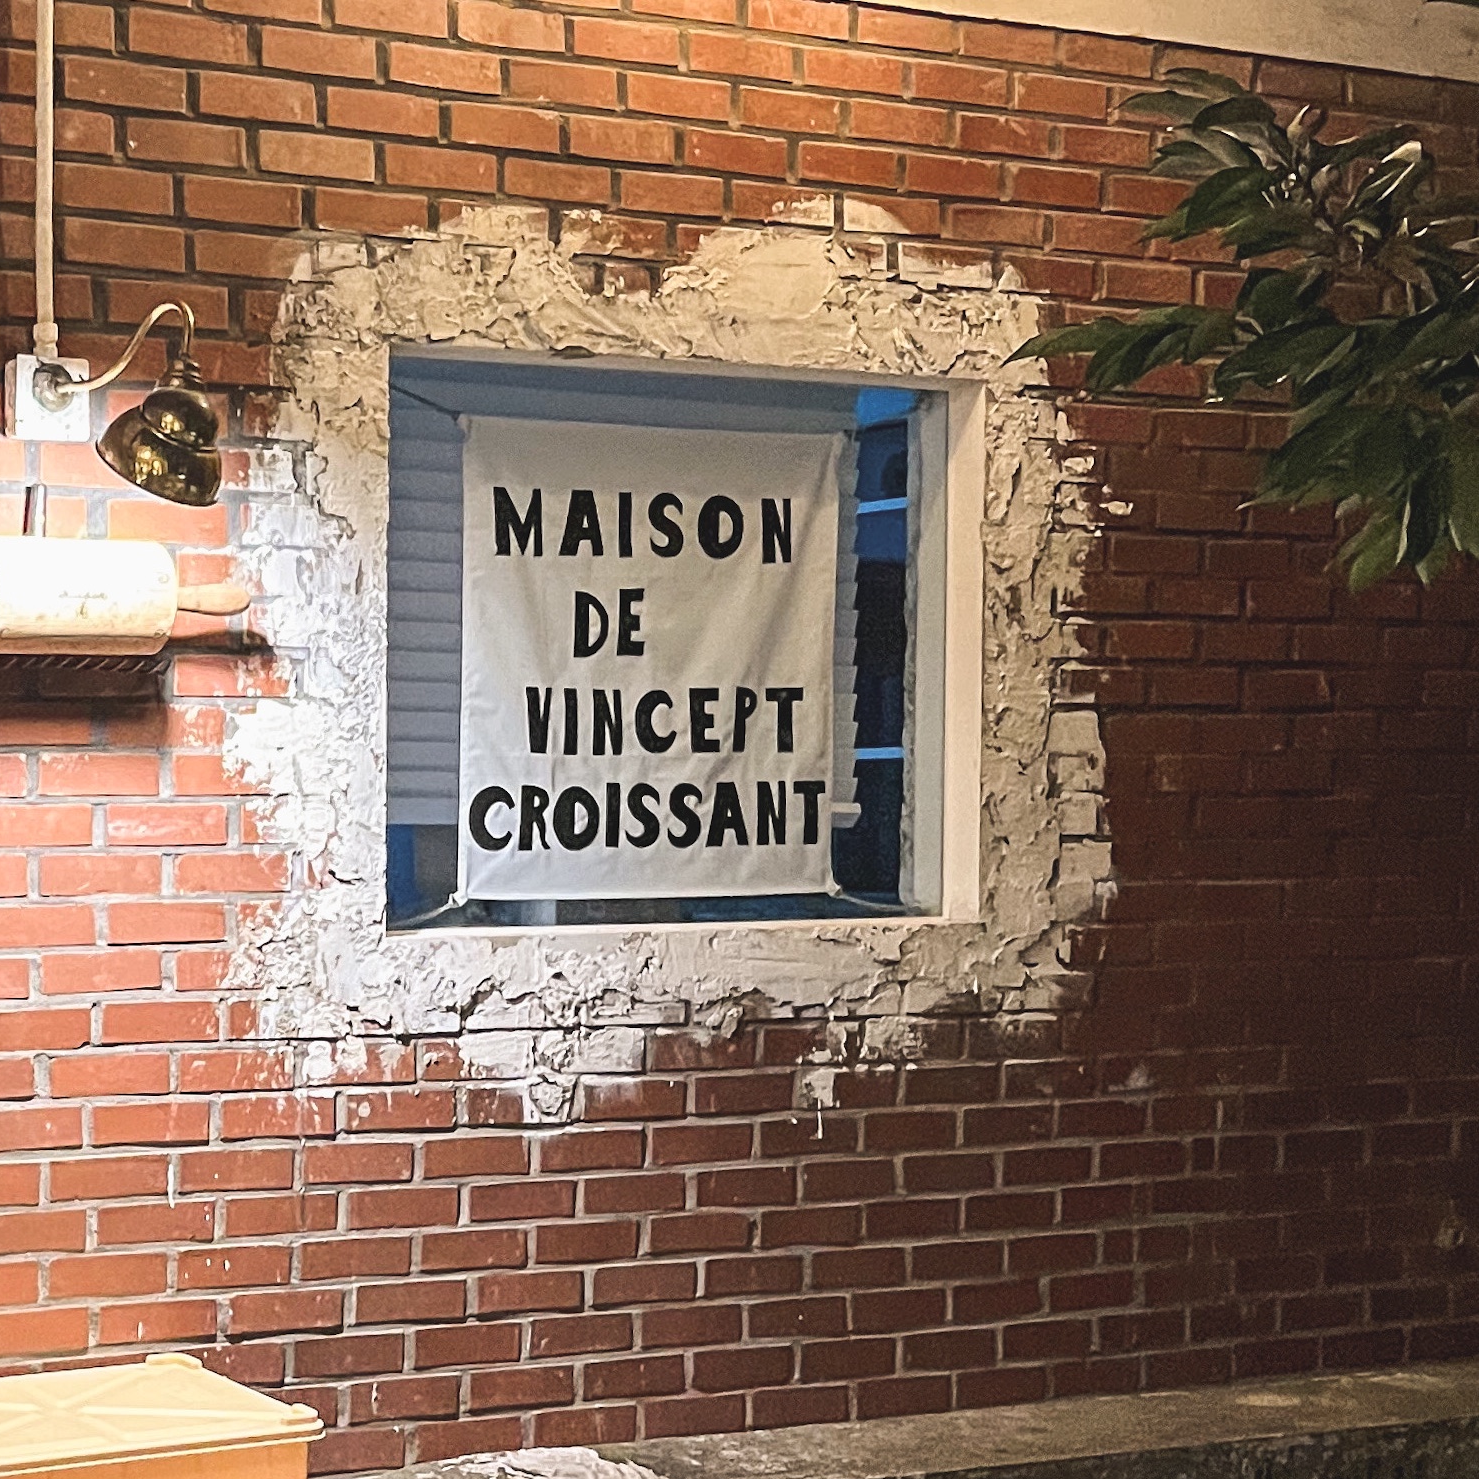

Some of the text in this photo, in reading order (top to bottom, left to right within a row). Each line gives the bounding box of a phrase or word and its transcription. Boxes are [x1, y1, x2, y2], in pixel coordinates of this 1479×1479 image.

[493, 486, 792, 564] MAISON
[573, 588, 645, 658] DE
[525, 686, 804, 756] VINCEPT
[468, 780, 826, 851] CROISSANT
